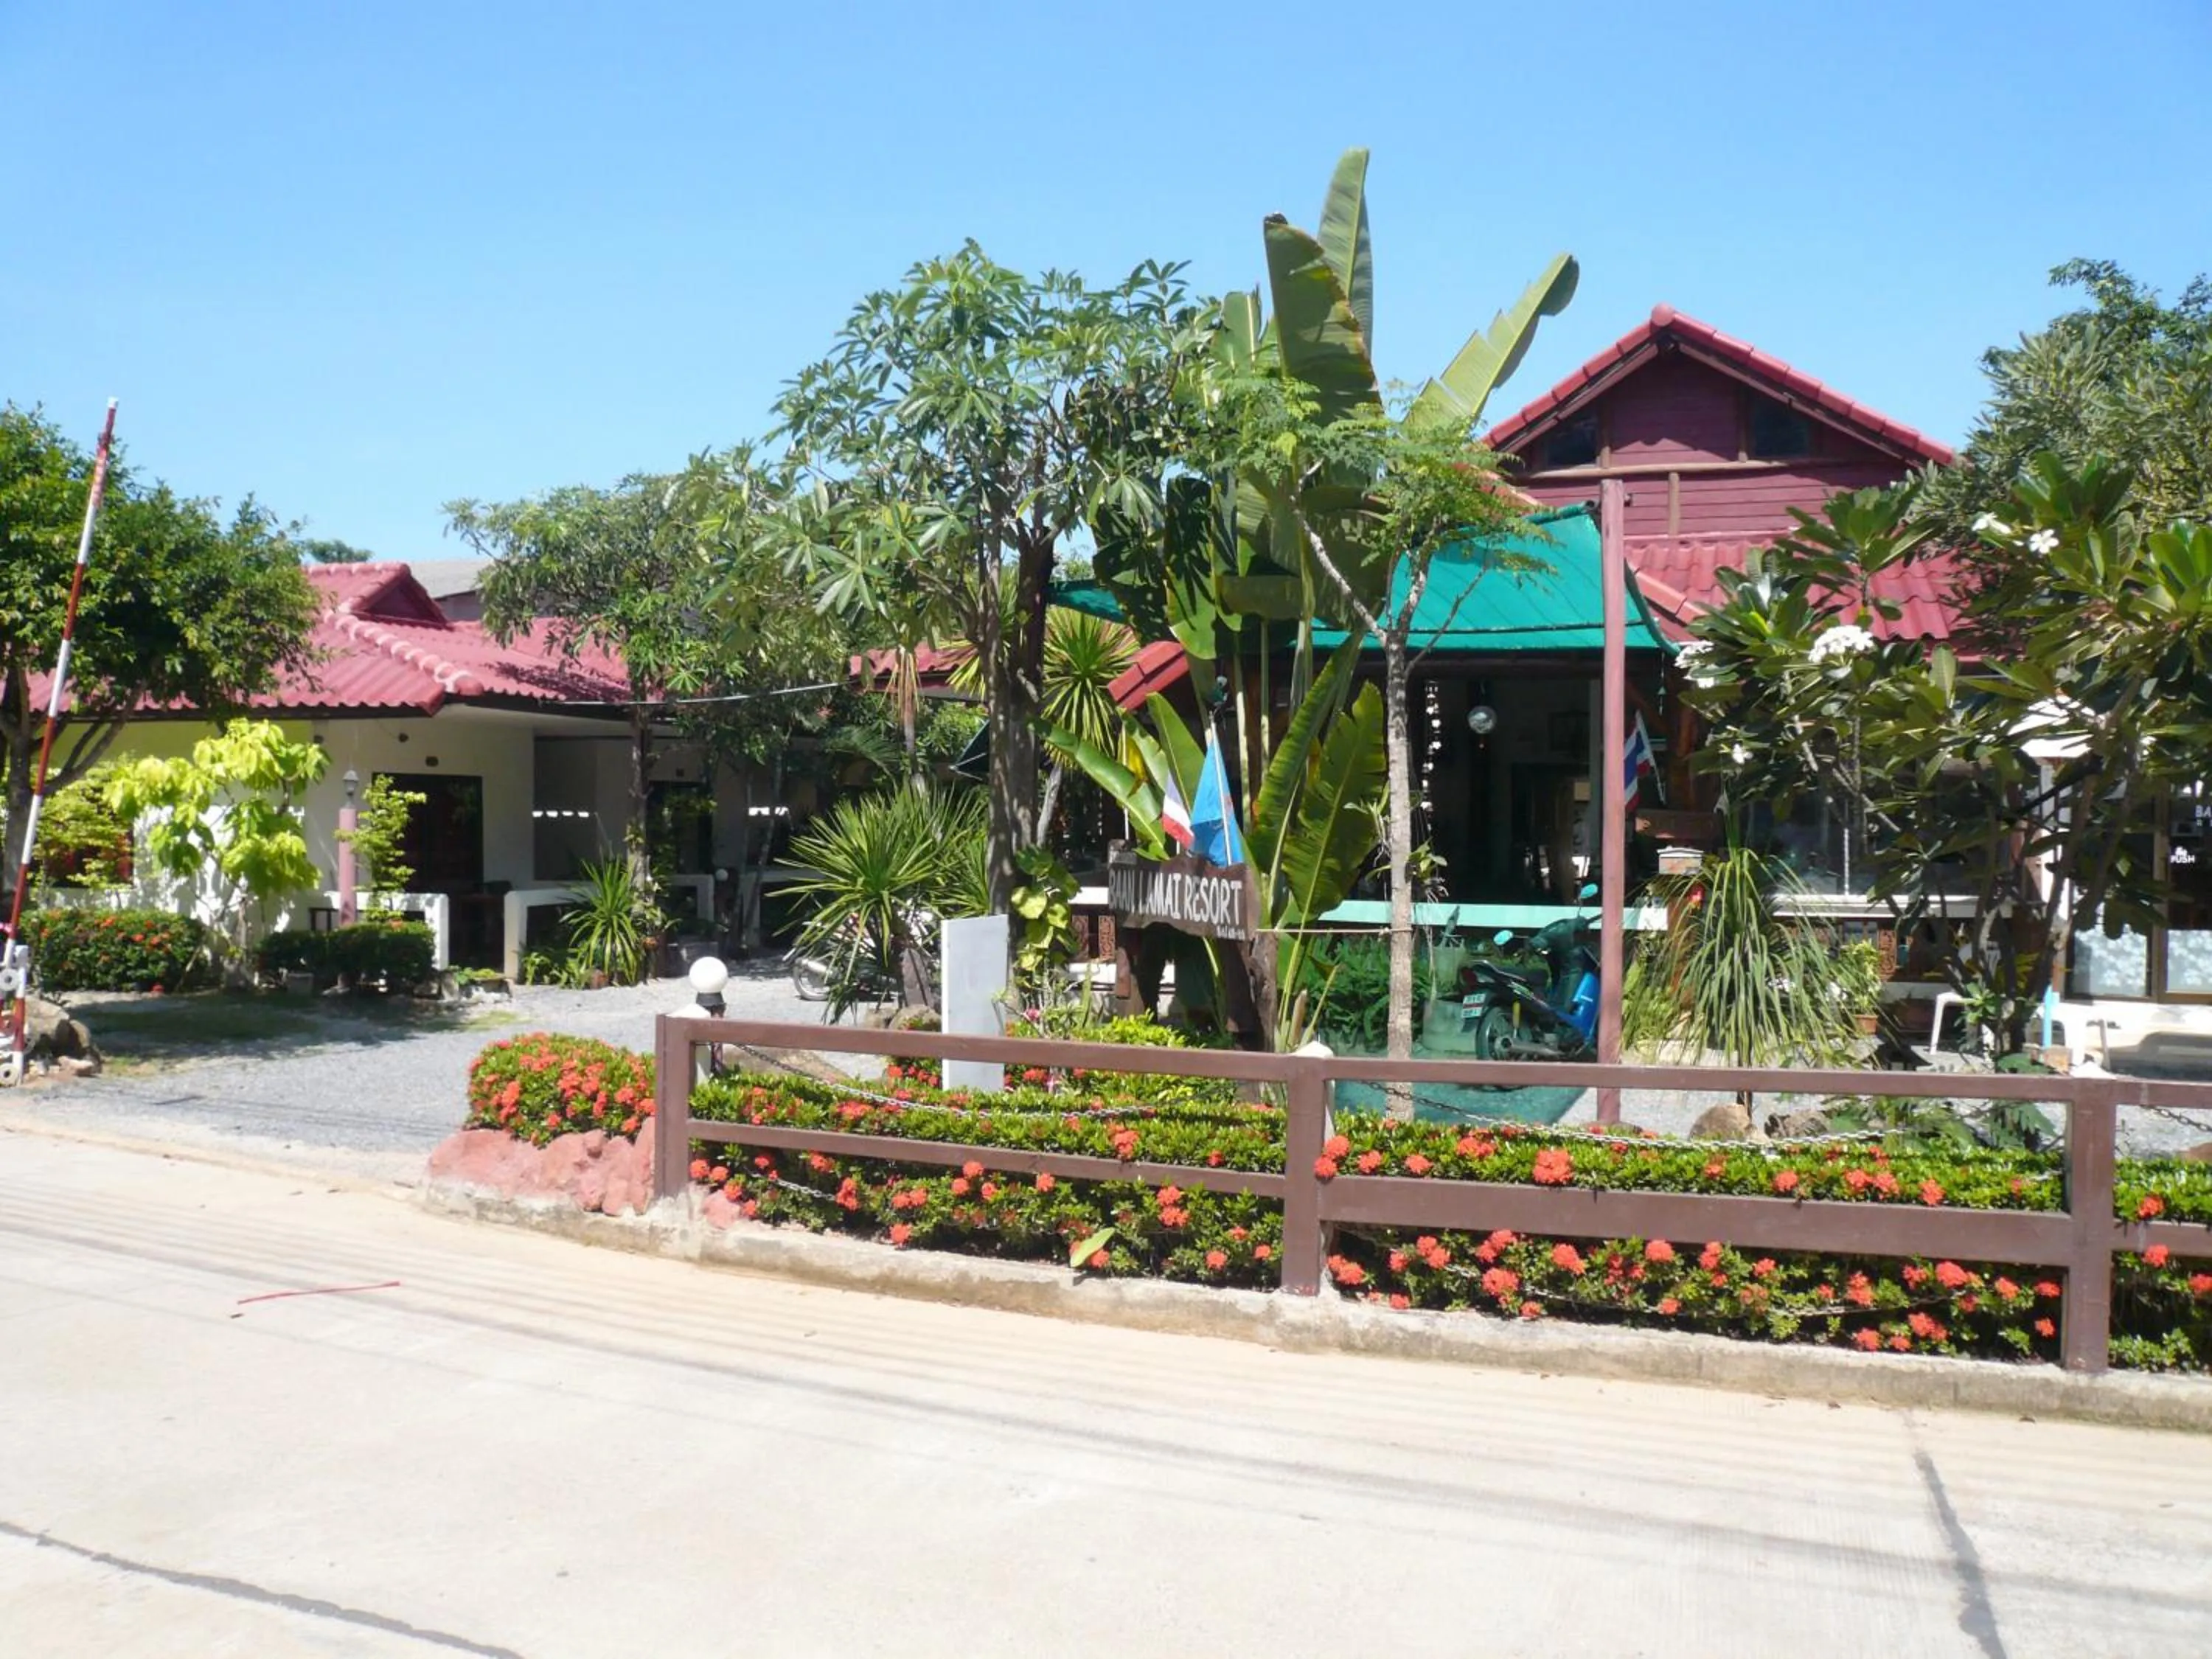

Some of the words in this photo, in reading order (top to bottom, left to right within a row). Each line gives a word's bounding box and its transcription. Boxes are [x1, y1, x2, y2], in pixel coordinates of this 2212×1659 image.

[2170, 855, 2195, 863] PUSH
[1138, 870, 1181, 920] LAMAI
[1183, 874, 1242, 925] RESORT
